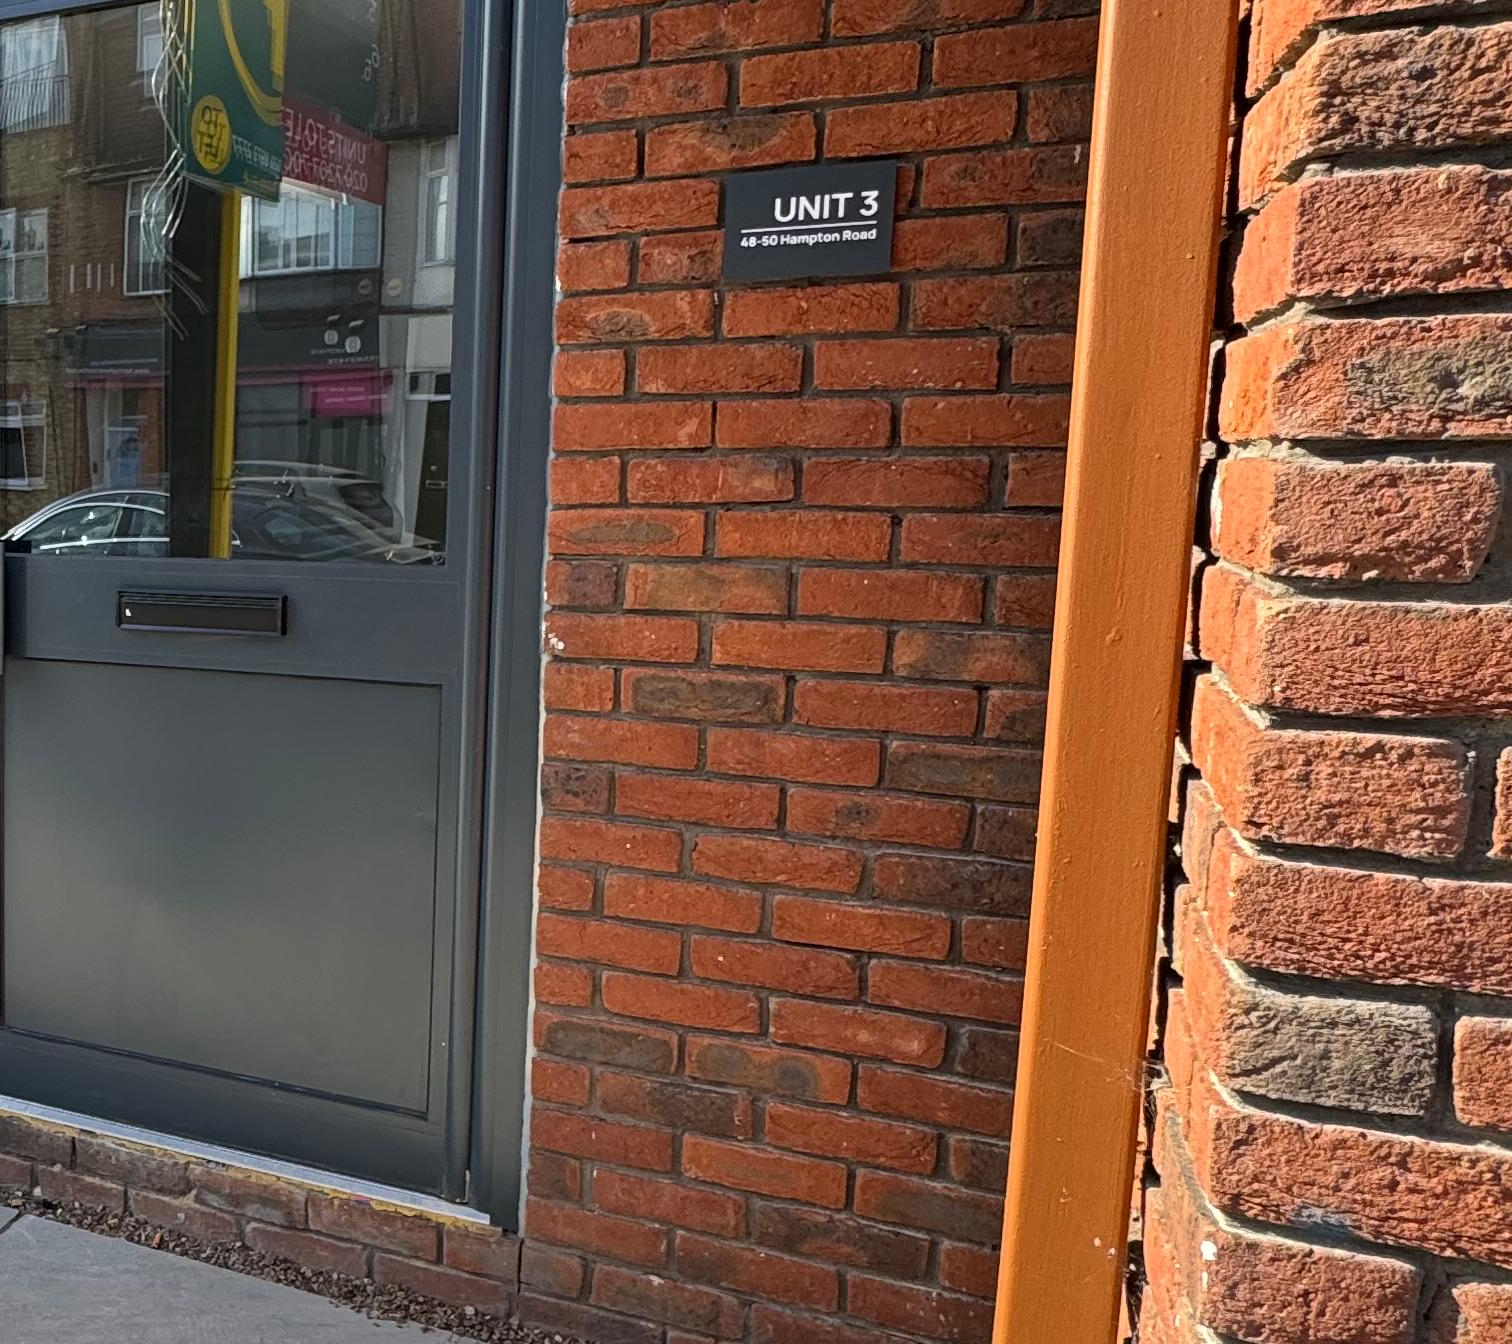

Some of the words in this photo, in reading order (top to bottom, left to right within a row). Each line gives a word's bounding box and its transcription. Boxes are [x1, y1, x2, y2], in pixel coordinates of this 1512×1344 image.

[774, 192, 854, 223] UNIT
[859, 190, 879, 217] 3
[740, 234, 778, 248] 48-50
[780, 232, 841, 246] Hampton
[842, 228, 877, 242] Road
